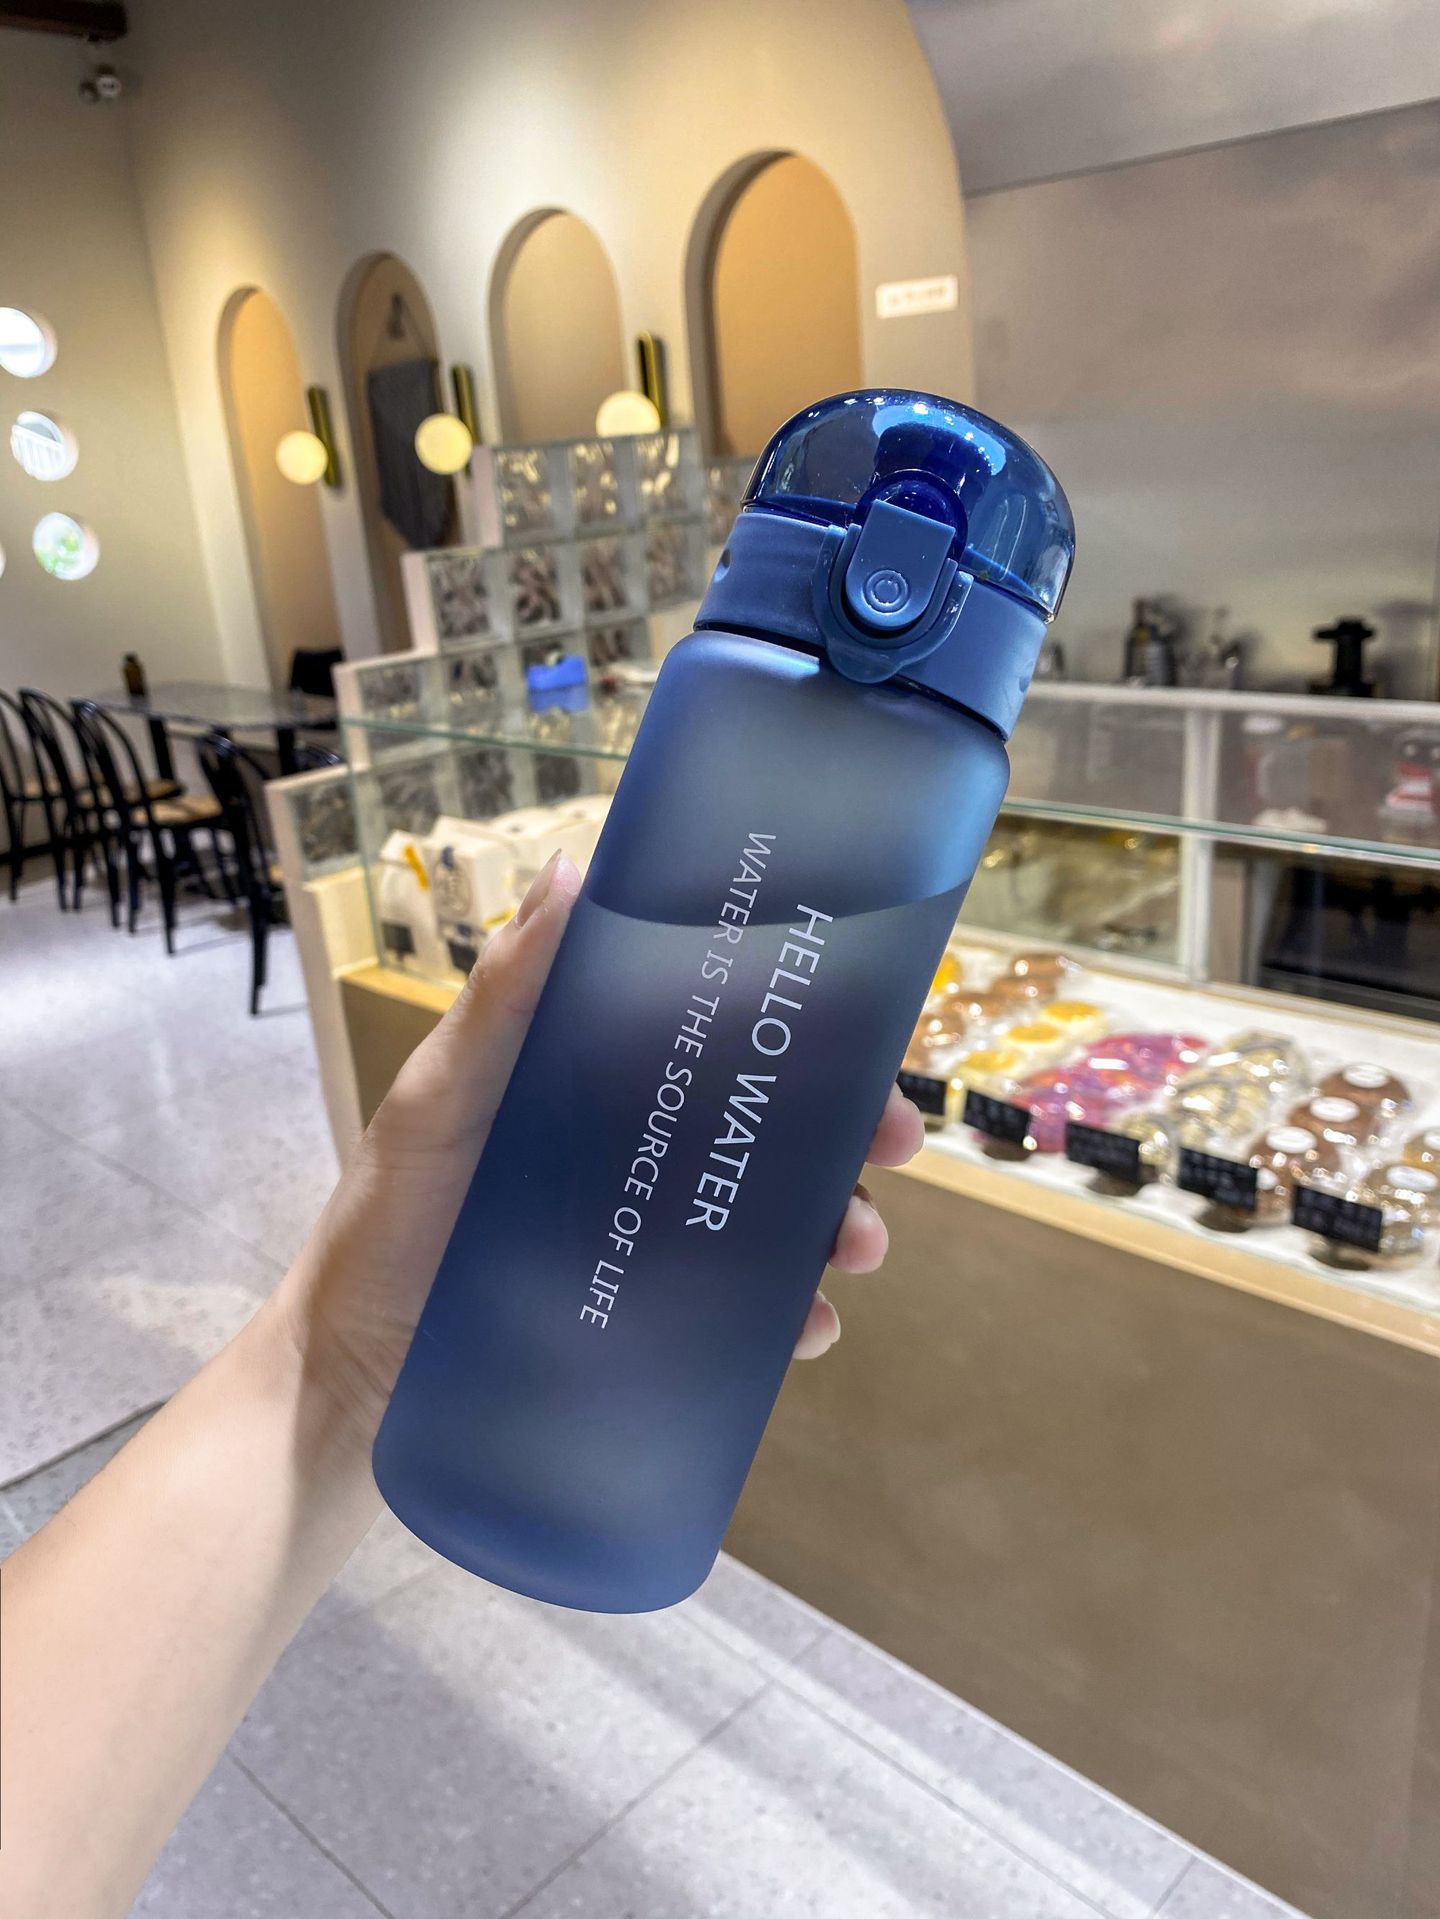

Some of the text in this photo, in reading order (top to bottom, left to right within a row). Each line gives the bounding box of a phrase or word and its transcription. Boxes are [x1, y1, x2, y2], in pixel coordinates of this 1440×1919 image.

[579, 832, 777, 1329] WATER IS THE SOURCE OF LIFE
[685, 904, 833, 1232] HELLO WATER
